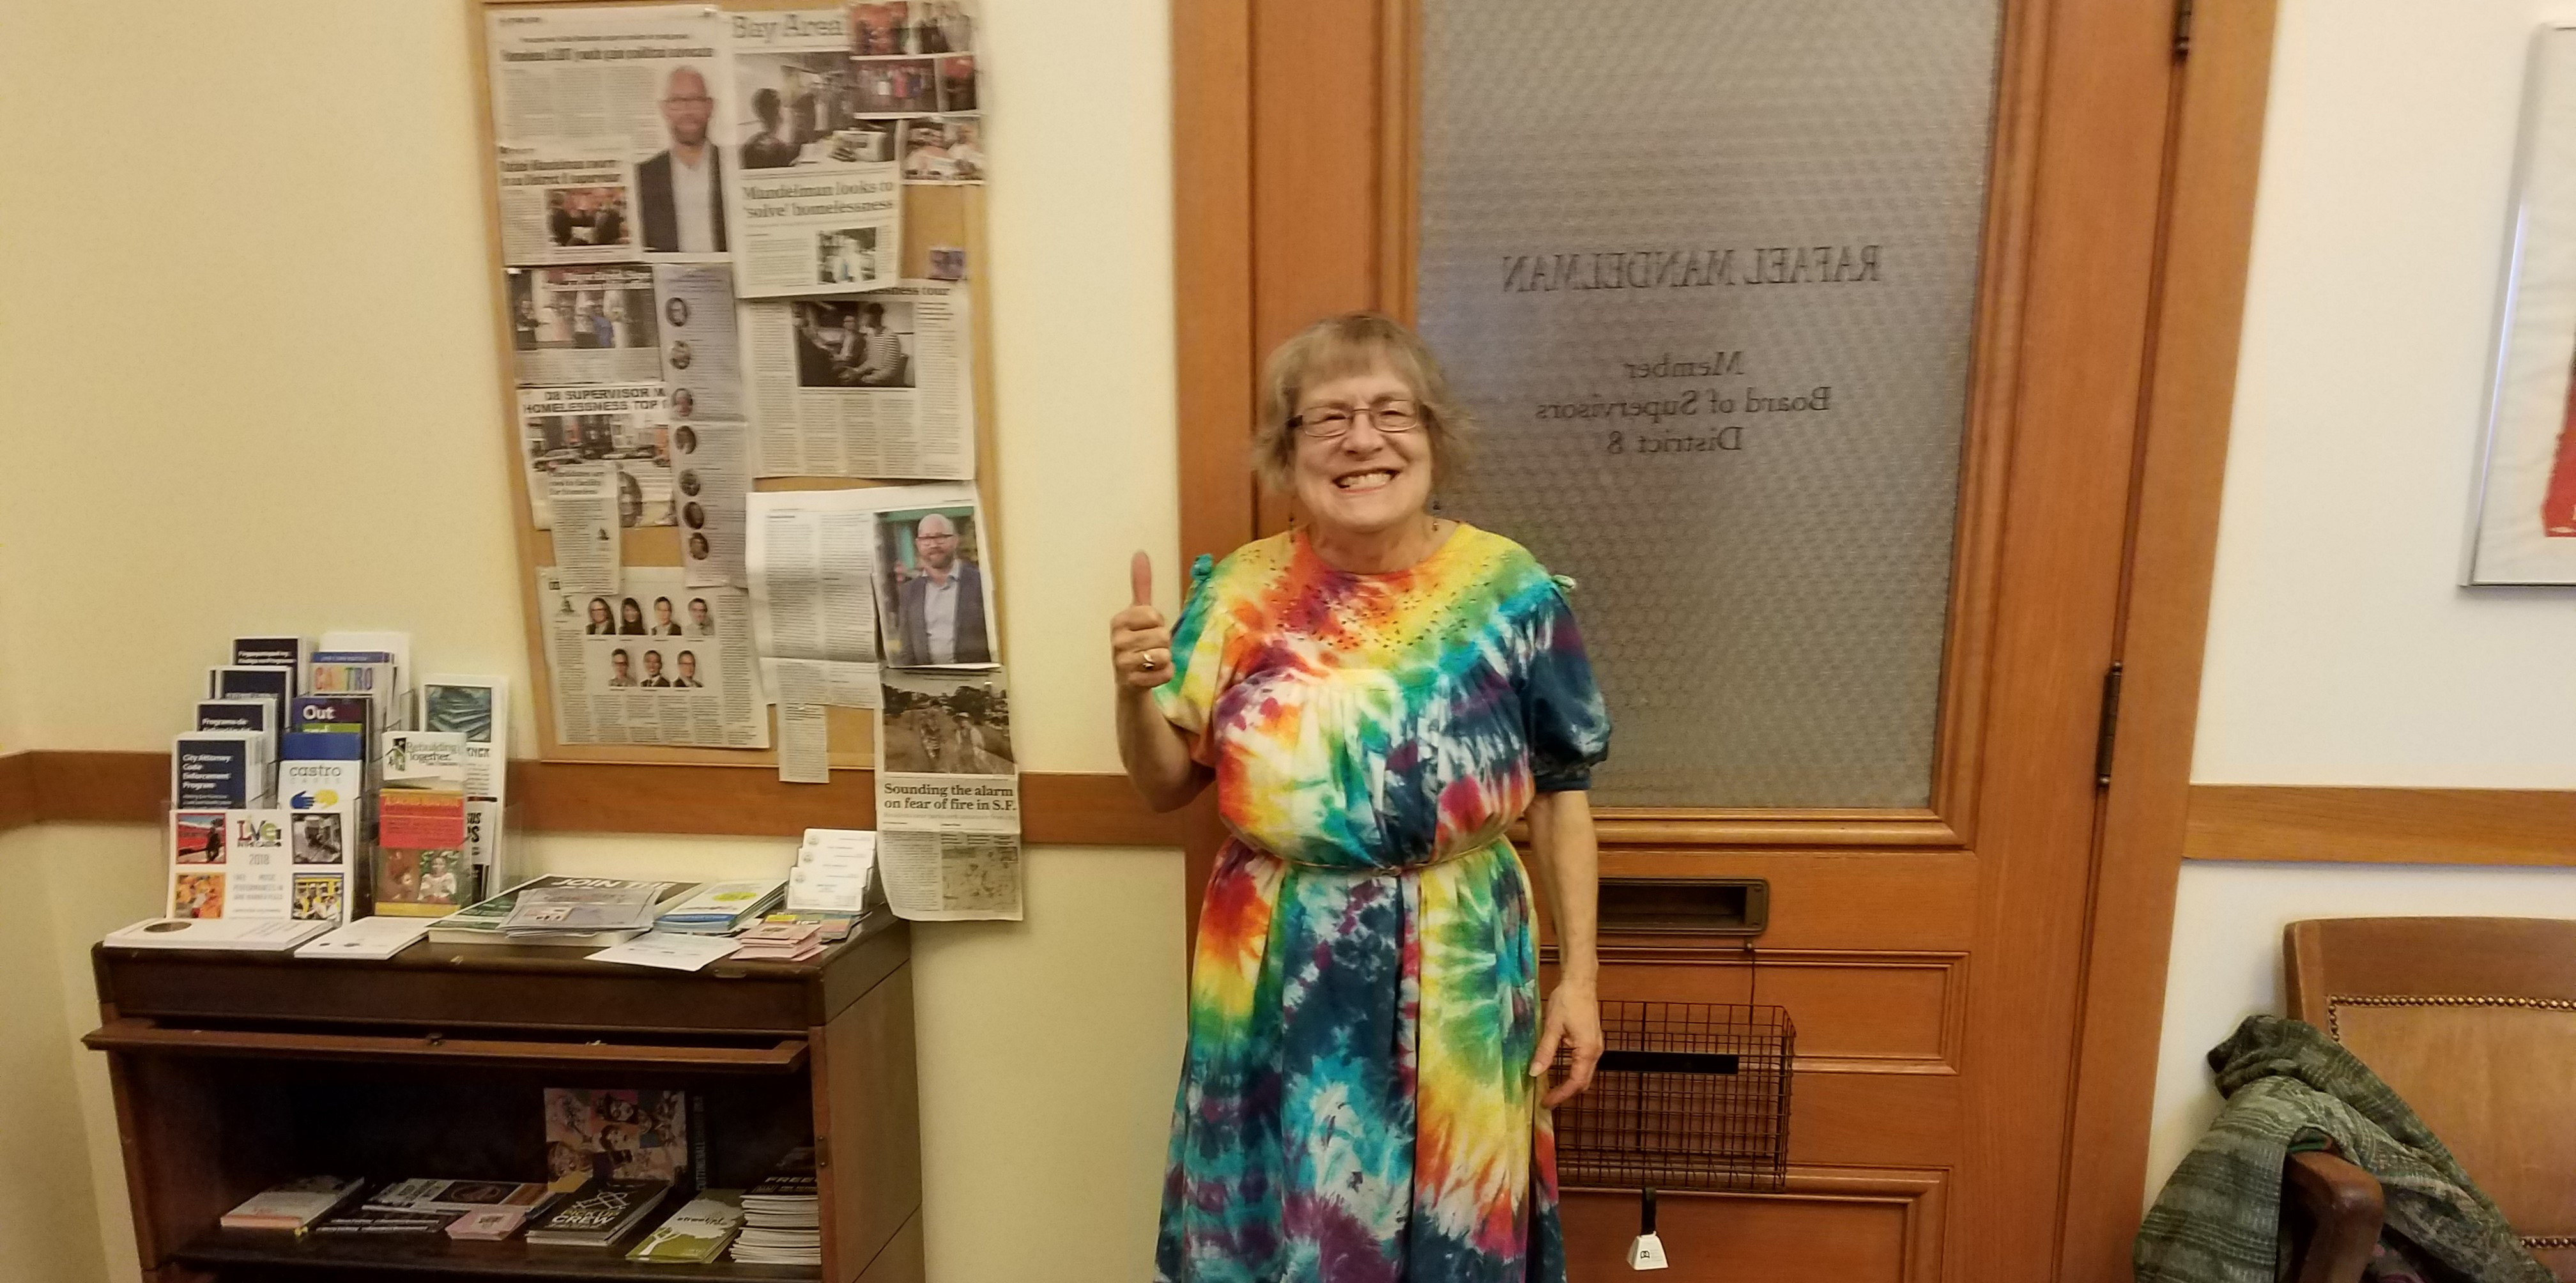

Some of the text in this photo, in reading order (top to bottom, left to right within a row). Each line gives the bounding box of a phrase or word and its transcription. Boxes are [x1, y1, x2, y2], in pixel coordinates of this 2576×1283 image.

[732, 13, 844, 43] Bay Area
[742, 181, 893, 200] Mandelman looks to
[791, 199, 893, 216] homelessness
[565, 388, 648, 399] SUPERVISOR
[525, 402, 628, 413] HOMELESSNESS
[632, 399, 657, 410] TOP
[303, 705, 336, 720] Out
[406, 741, 457, 754] Rebuilding
[183, 754, 197, 764] City
[289, 765, 342, 777] castro
[183, 781, 217, 790] Program
[884, 783, 1013, 797] Sounding the alarm
[884, 797, 1017, 811] on fear of fire in S.F.
[249, 854, 270, 865] 2018
[551, 879, 622, 887] JOIN
[551, 1215, 616, 1224] CREW
